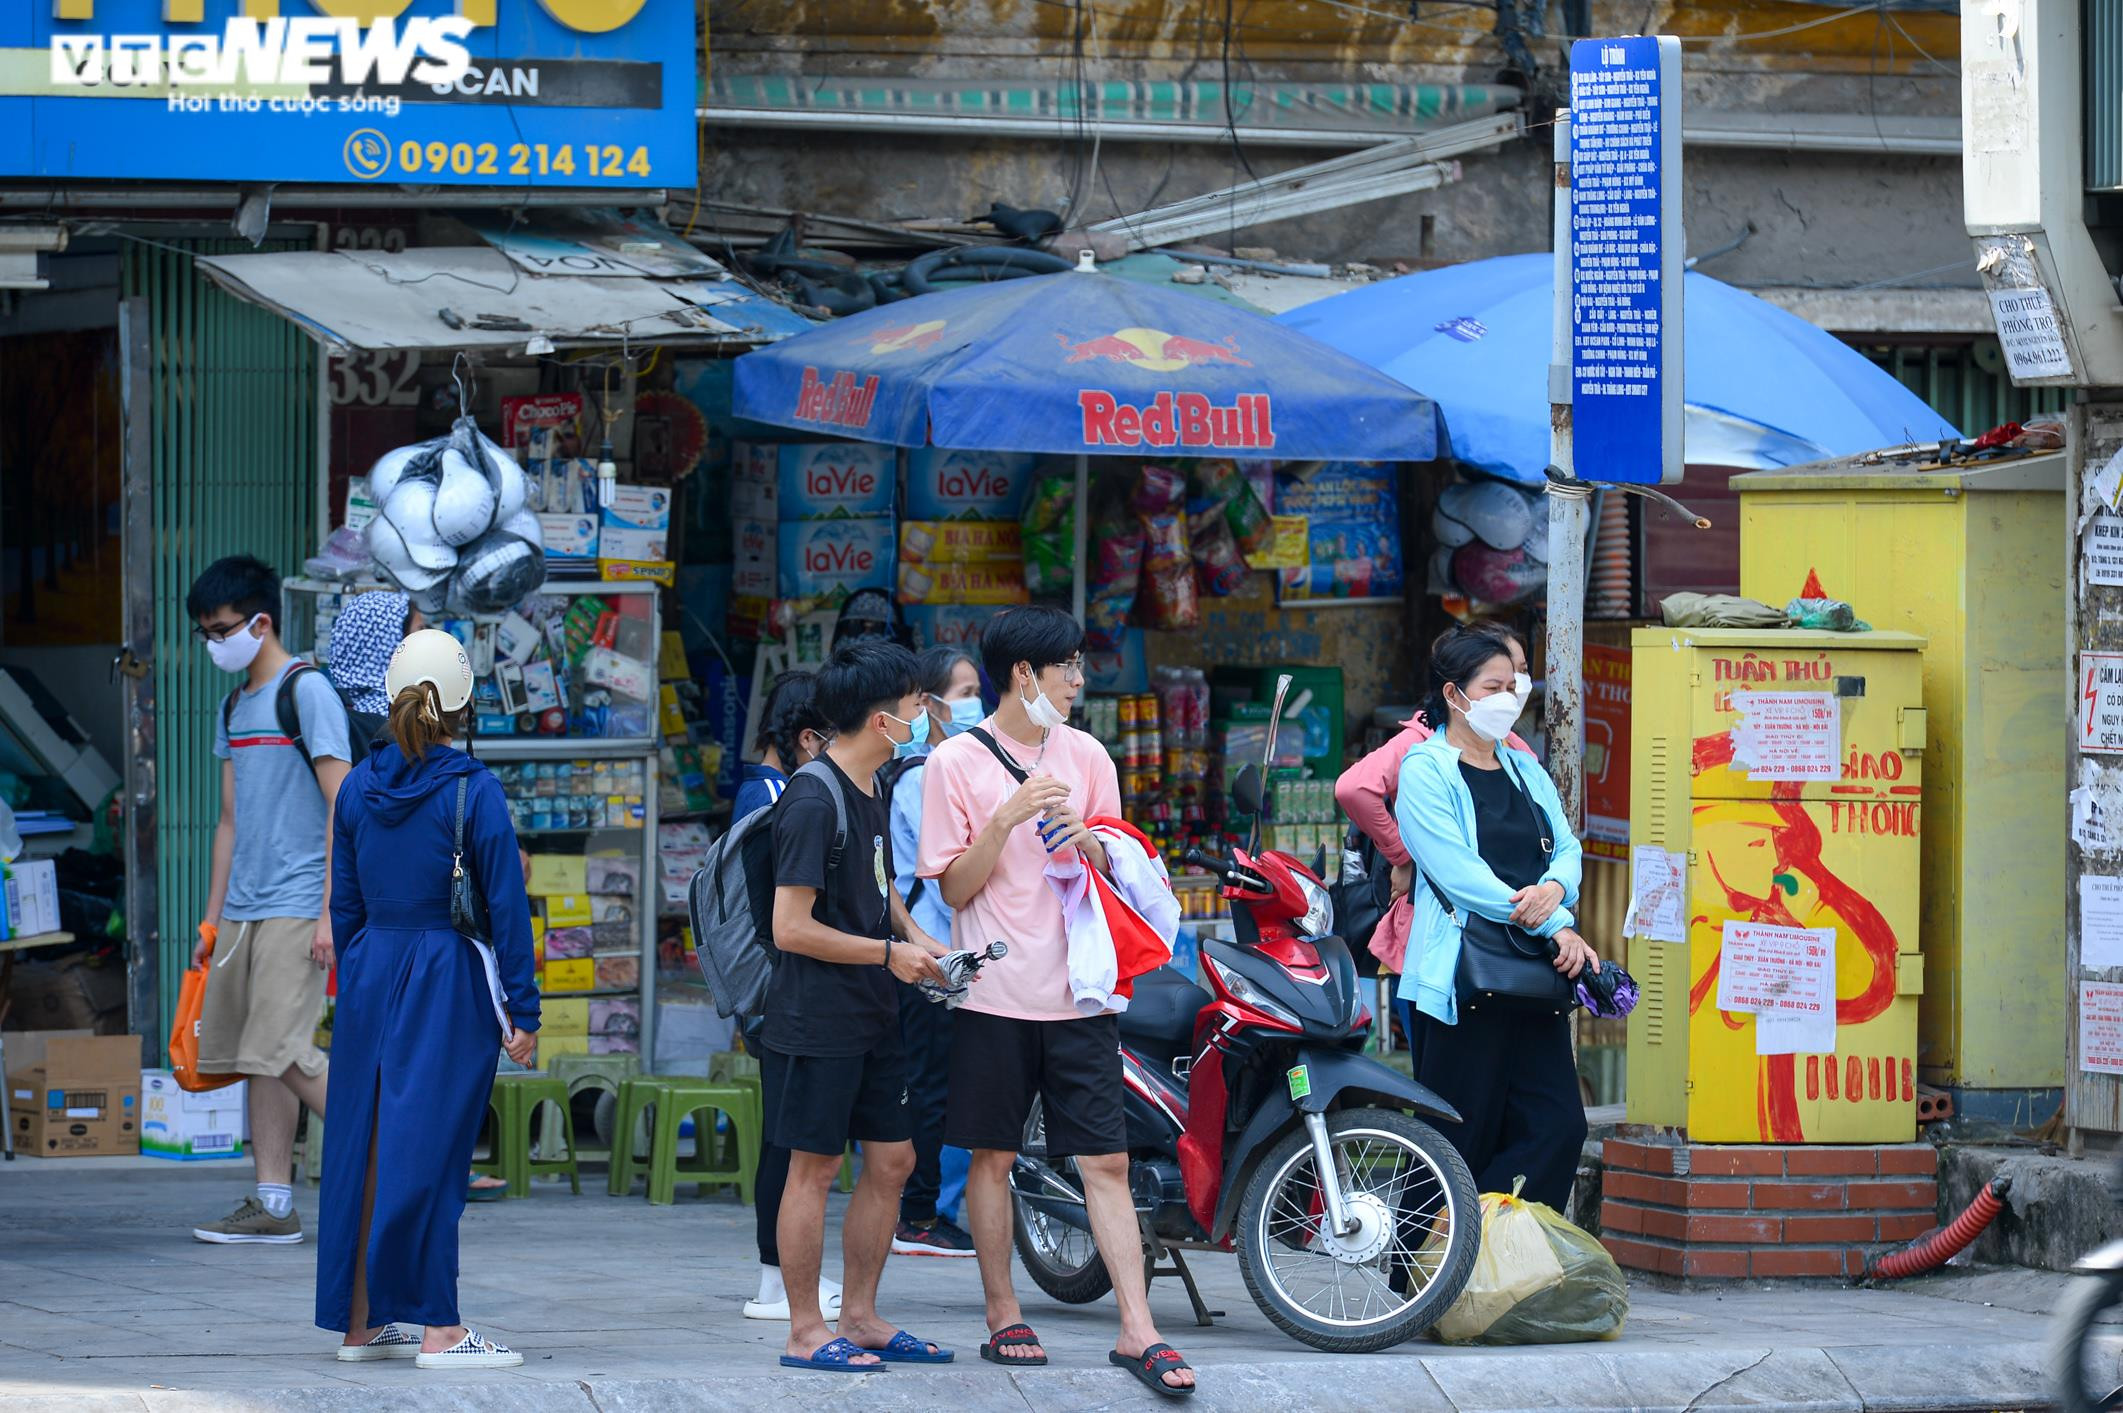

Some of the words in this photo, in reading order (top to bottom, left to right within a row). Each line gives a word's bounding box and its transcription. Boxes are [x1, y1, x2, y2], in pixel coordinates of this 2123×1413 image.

[400, 141, 499, 175] 0902
[508, 143, 576, 176] 214
[585, 144, 652, 177] 124
[1999, 299, 2019, 313] CHO
[2002, 315, 2034, 334] PHÒNG
[2033, 316, 2053, 332] TRỌ
[1712, 653, 1777, 682] TUÂN
[1782, 653, 1832, 682] THỦ
[2107, 692, 2116, 706] CÓ
[2102, 714, 2120, 726] NGUY
[2101, 728, 2117, 744] CHẾT
[1825, 792, 1920, 837] THÔNG
